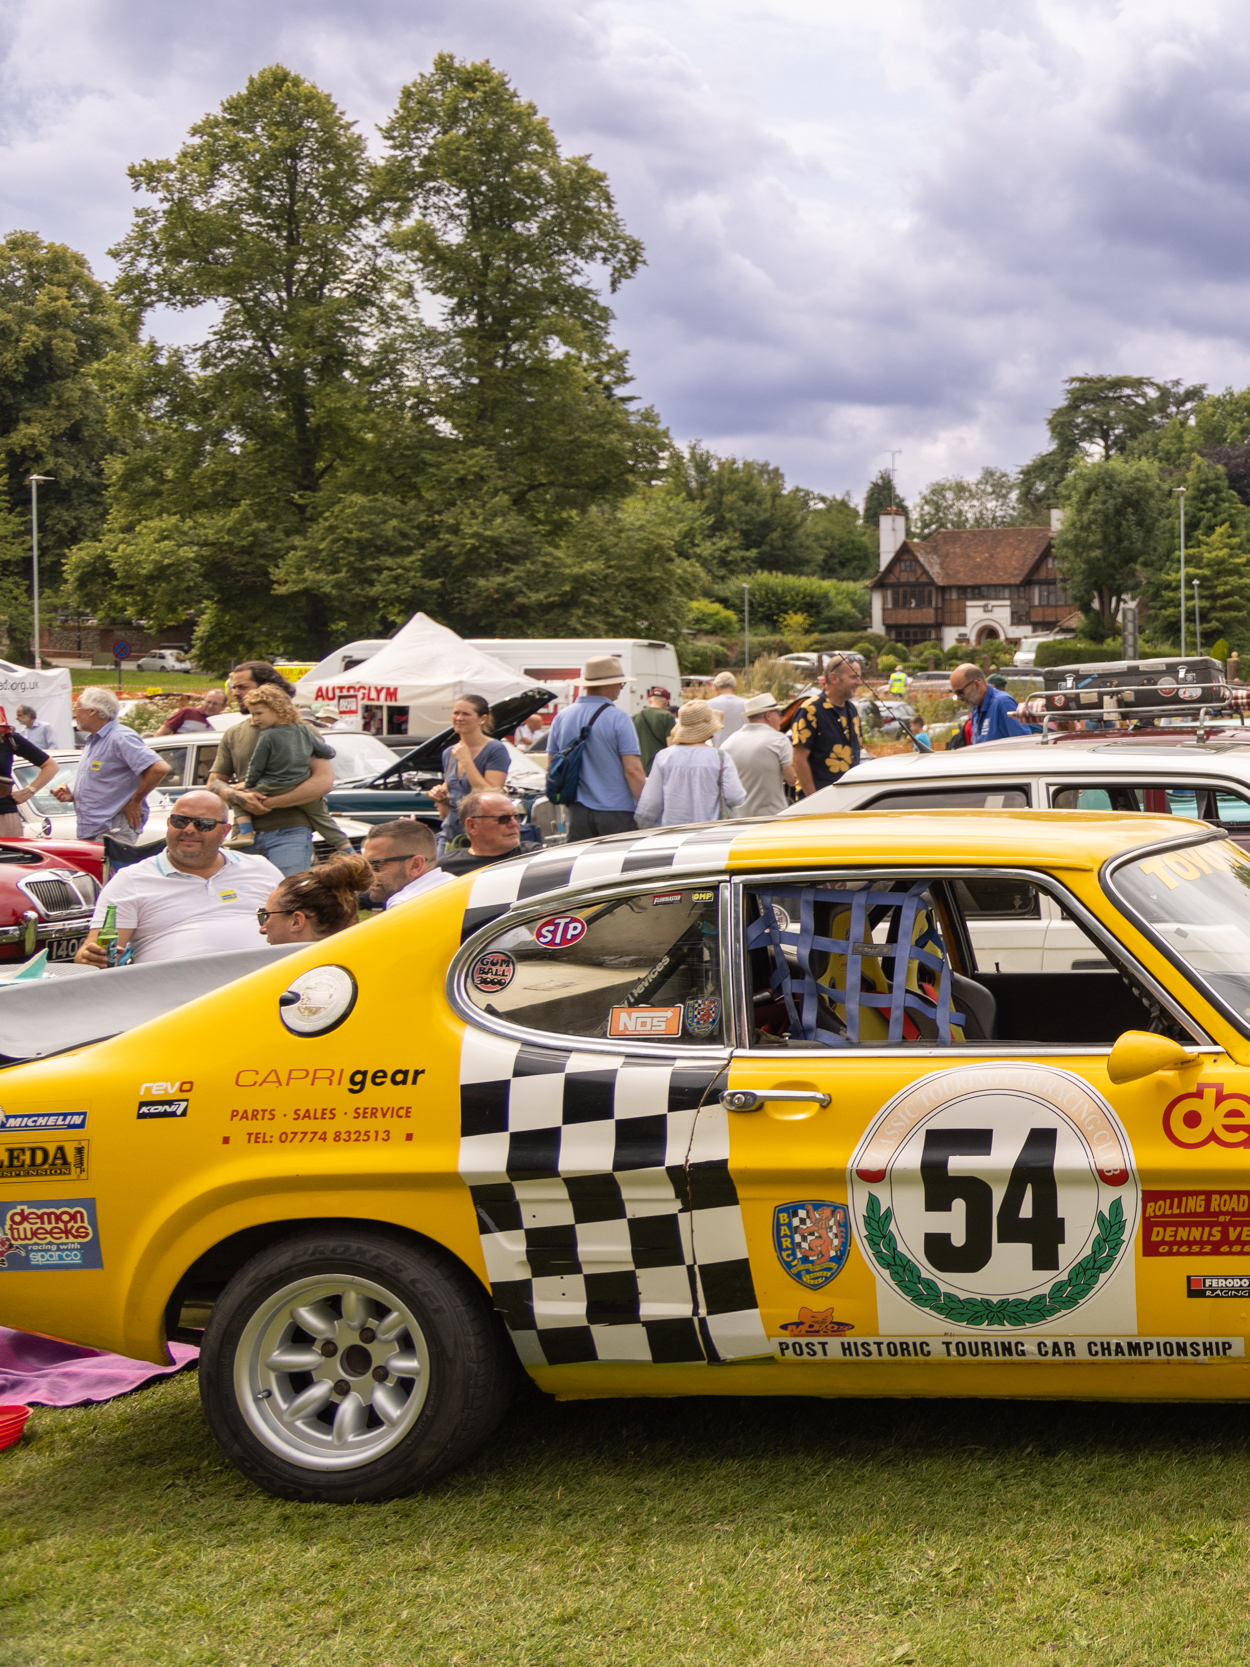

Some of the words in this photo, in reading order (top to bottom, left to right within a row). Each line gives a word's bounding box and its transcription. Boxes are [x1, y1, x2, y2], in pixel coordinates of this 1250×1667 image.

[538, 917, 583, 945] STP
[480, 957, 511, 967] GUM
[478, 967, 508, 977] BALL
[618, 1011, 670, 1031] NOS
[139, 1081, 194, 1095] revo
[235, 1068, 344, 1087] CAPRI
[347, 1068, 426, 1094] gear
[139, 1103, 185, 1114] KONI
[230, 1108, 276, 1121] PARTS
[292, 1108, 336, 1121] SALES
[352, 1106, 413, 1119] SERVICE
[6, 1115, 84, 1127] MICHELIN
[863, 1101, 921, 1171] CLASSIC
[916, 1072, 1000, 1107] TOURING
[1005, 1072, 1040, 1089] CAR
[1041, 1081, 1101, 1131] RACING
[1092, 1130, 1120, 1177] CLUB
[246, 1132, 273, 1144] TEL:
[278, 1131, 328, 1143] 07774
[332, 1130, 391, 1143] 832513
[920, 1127, 1065, 1274] 54
[1145, 1194, 1206, 1217] ROLLING
[1210, 1194, 1249, 1212] ROAD
[9, 1208, 86, 1226] demon
[8, 1224, 91, 1242] tweeks
[778, 1213, 794, 1263] BARC
[1150, 1227, 1222, 1241] DENNIS
[28, 1243, 57, 1251] racing
[29, 1251, 81, 1264] sparco
[1205, 1278, 1249, 1287] FERODO
[1205, 1289, 1249, 1297] RACING
[778, 1341, 829, 1359] POST
[841, 1341, 931, 1359] HISTORIC
[941, 1341, 1027, 1359] TOURING
[1036, 1341, 1076, 1359] CAR
[1087, 1340, 1234, 1358] CHAMPIONSHIP
